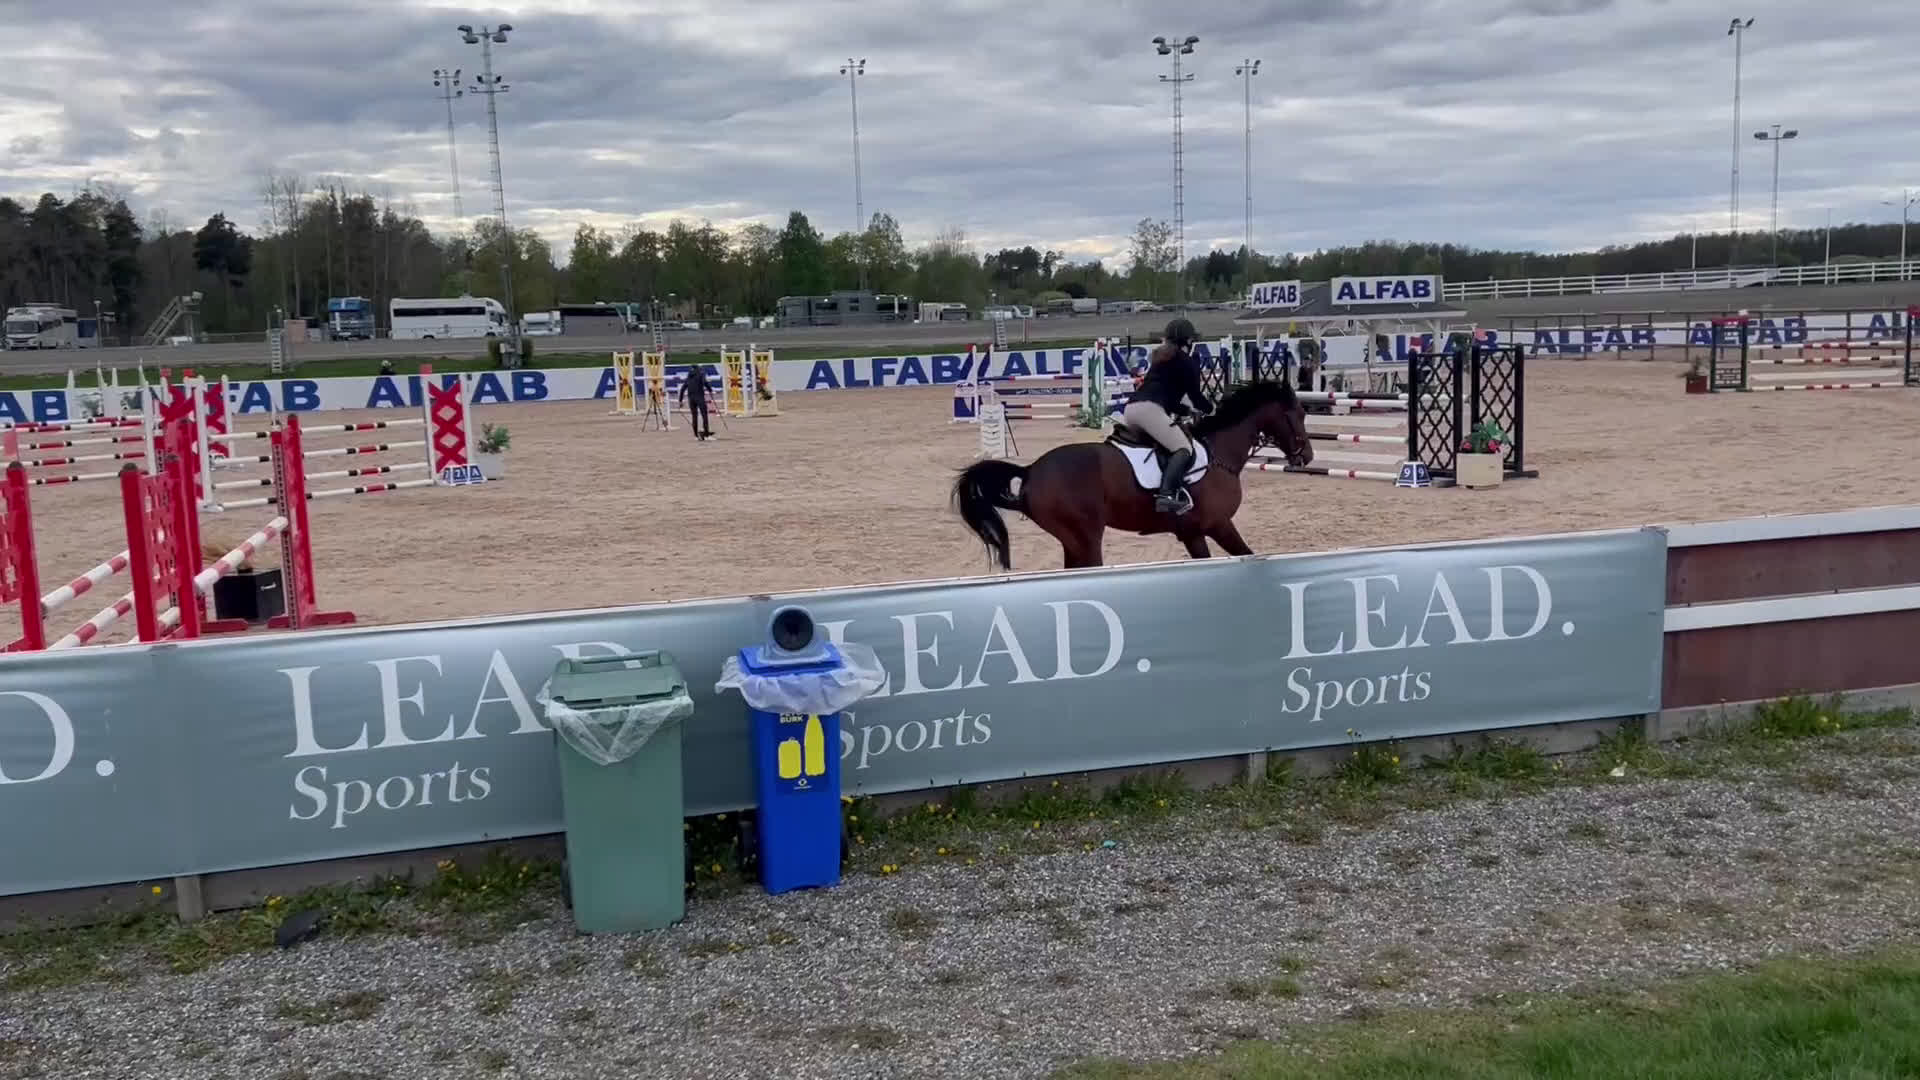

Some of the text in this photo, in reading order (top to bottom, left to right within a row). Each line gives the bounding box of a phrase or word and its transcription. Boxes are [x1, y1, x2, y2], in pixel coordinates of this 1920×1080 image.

[1253, 284, 1297, 305] ALFAB
[1337, 279, 1431, 300] ALFAB
[806, 354, 964, 389] ALFAB
[1281, 565, 1575, 660] LEAD.
[275, 641, 643, 758] LEA
[1281, 665, 1431, 722] Sports
[289, 761, 491, 830] Sports
